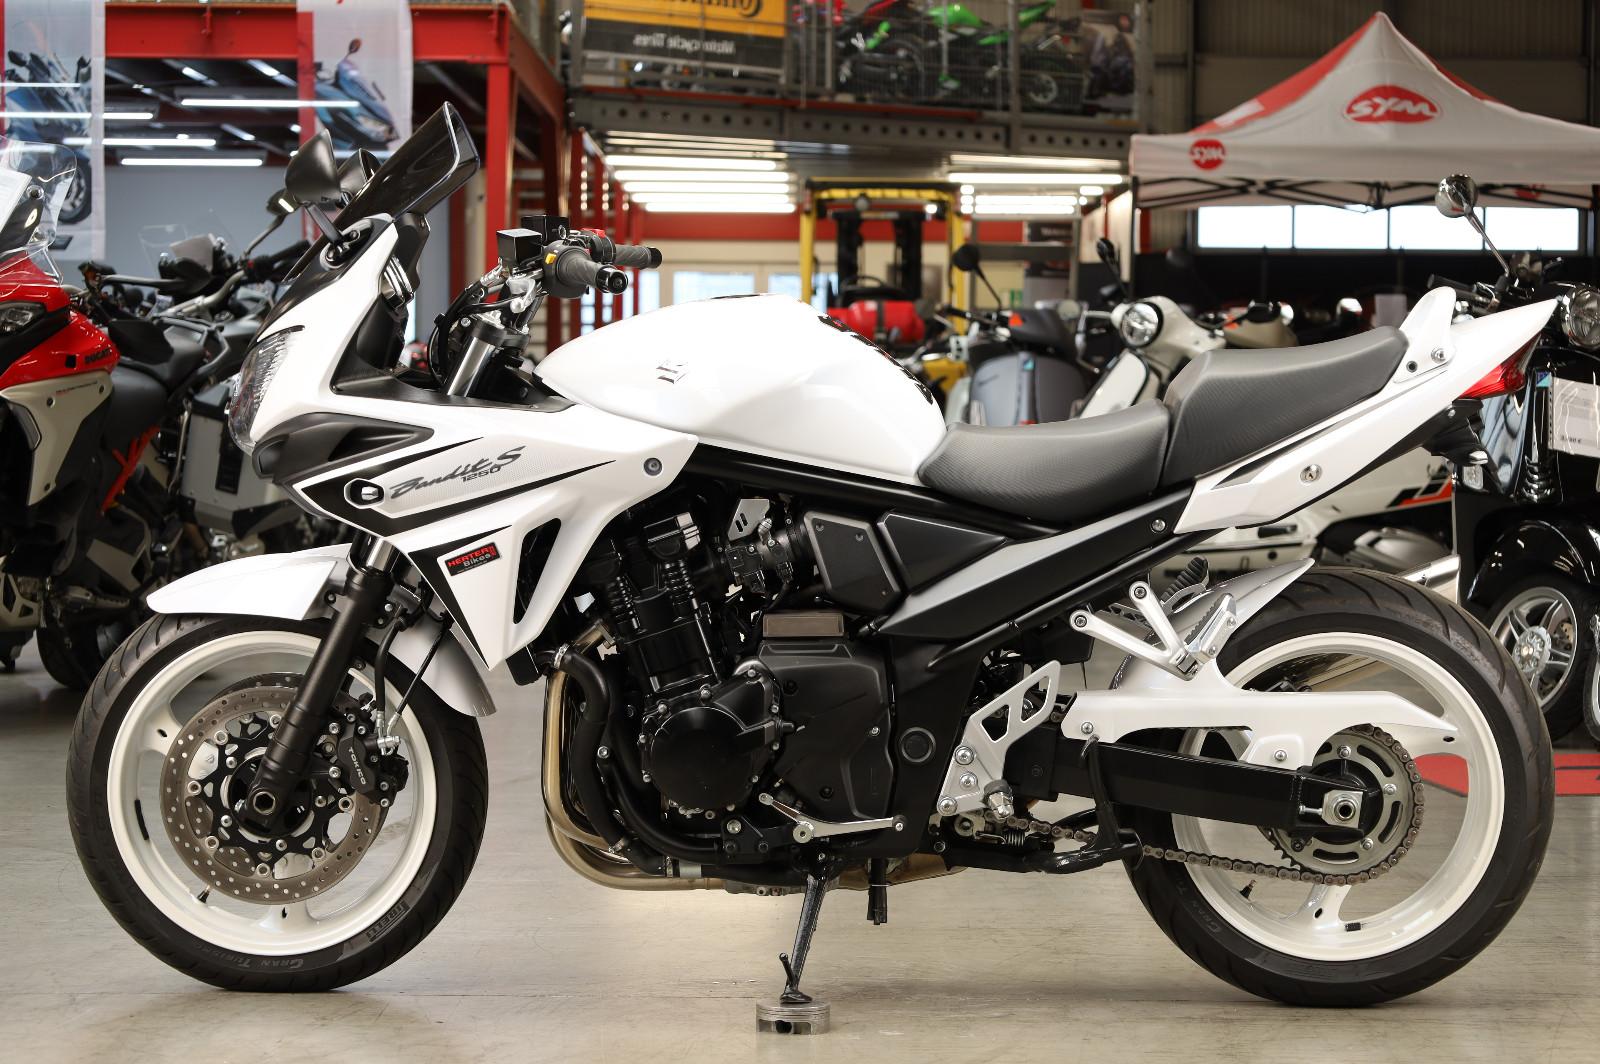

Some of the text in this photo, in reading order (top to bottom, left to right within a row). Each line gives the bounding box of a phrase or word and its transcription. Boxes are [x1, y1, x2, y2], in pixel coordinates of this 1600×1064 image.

[1346, 97, 1439, 118] SYM
[389, 445, 526, 499] Bandit S
[461, 464, 501, 482] 1250
[447, 547, 489, 567] HERTER
[463, 553, 491, 567] Bikes
[348, 746, 367, 785] TOKICO
[366, 900, 411, 943] PIRELLI
[260, 957, 304, 969] GRAN
